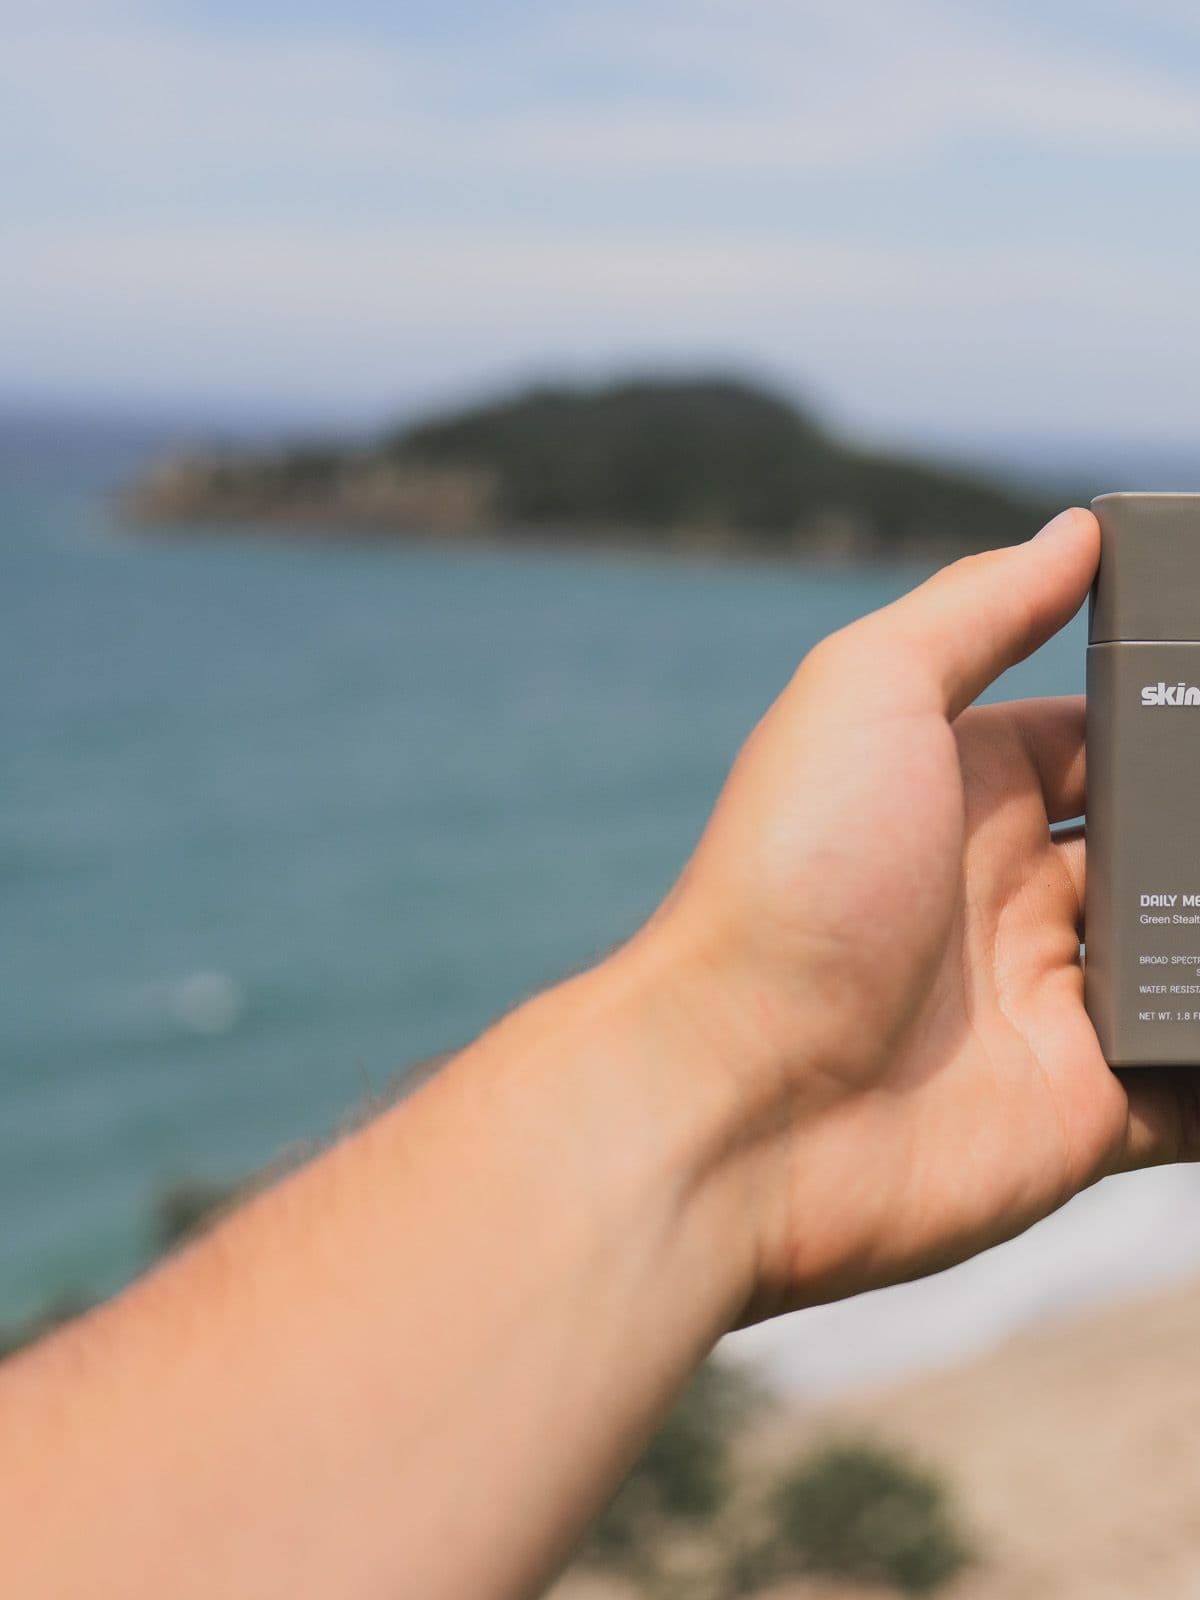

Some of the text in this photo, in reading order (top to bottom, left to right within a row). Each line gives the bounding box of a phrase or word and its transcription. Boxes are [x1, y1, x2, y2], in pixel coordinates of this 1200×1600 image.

[1140, 894, 1178, 907] DAILY
[1140, 914, 1170, 924] Green
[1139, 956, 1168, 964] BROAD
[1139, 985, 1167, 994] WATER
[1139, 1012, 1155, 1021] NET
[1158, 1012, 1173, 1021] WT.
[1177, 1012, 1190, 1021] 1.8
